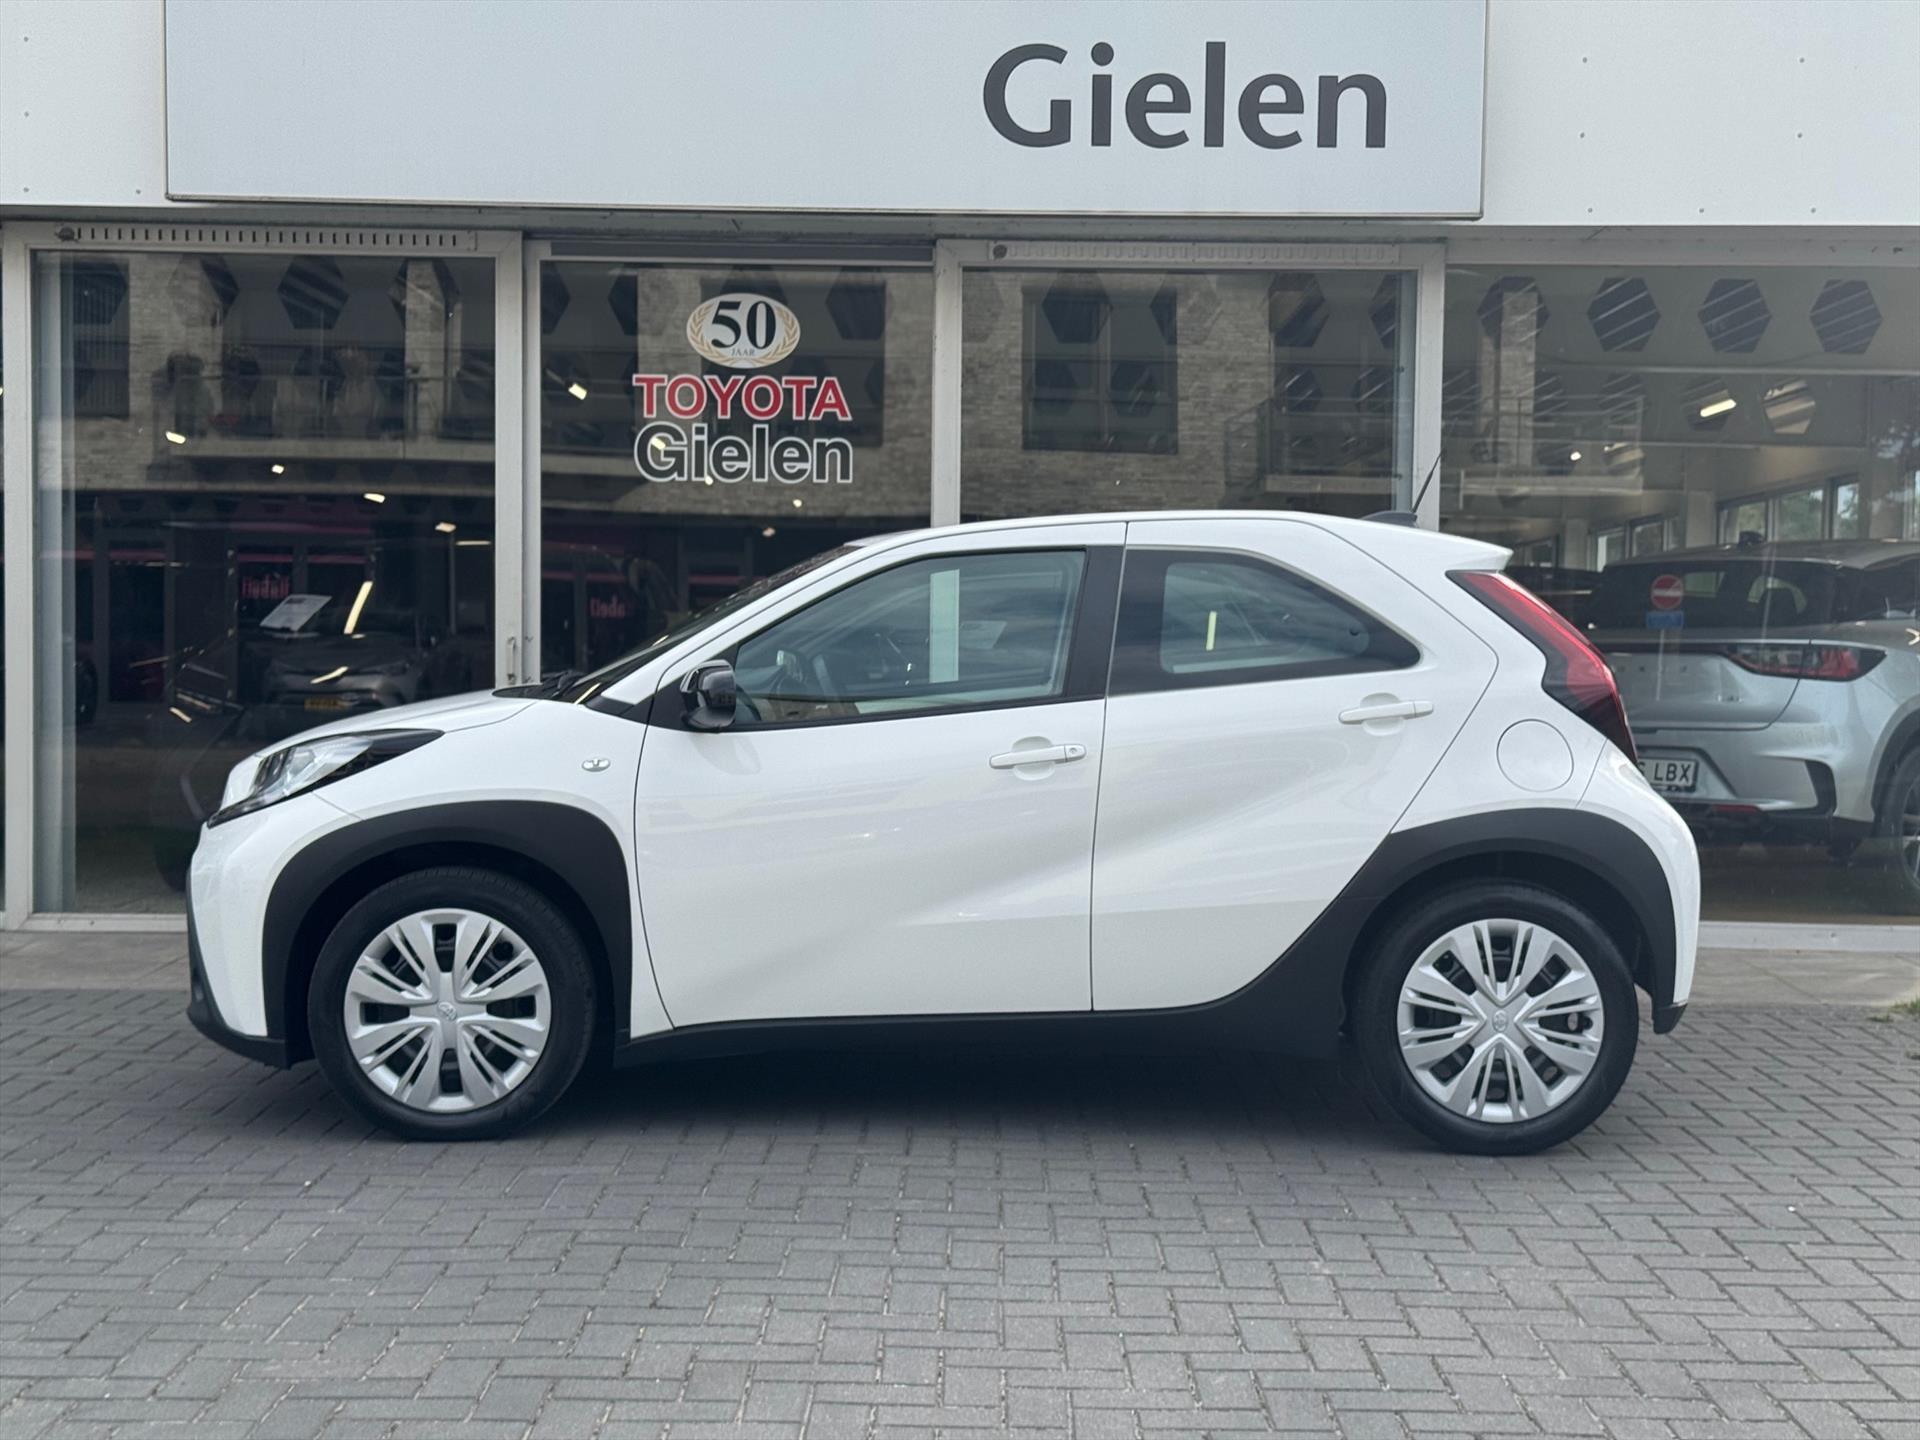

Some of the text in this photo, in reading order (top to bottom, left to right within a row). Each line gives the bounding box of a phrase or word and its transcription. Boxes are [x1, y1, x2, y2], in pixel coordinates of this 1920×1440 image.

[983, 41, 1387, 149] Gielen
[711, 300, 776, 349] 50
[730, 347, 756, 357] JAAR
[632, 374, 853, 421] TOYOTA
[633, 421, 853, 484] Gielen
[1653, 762, 1691, 783] LBX
